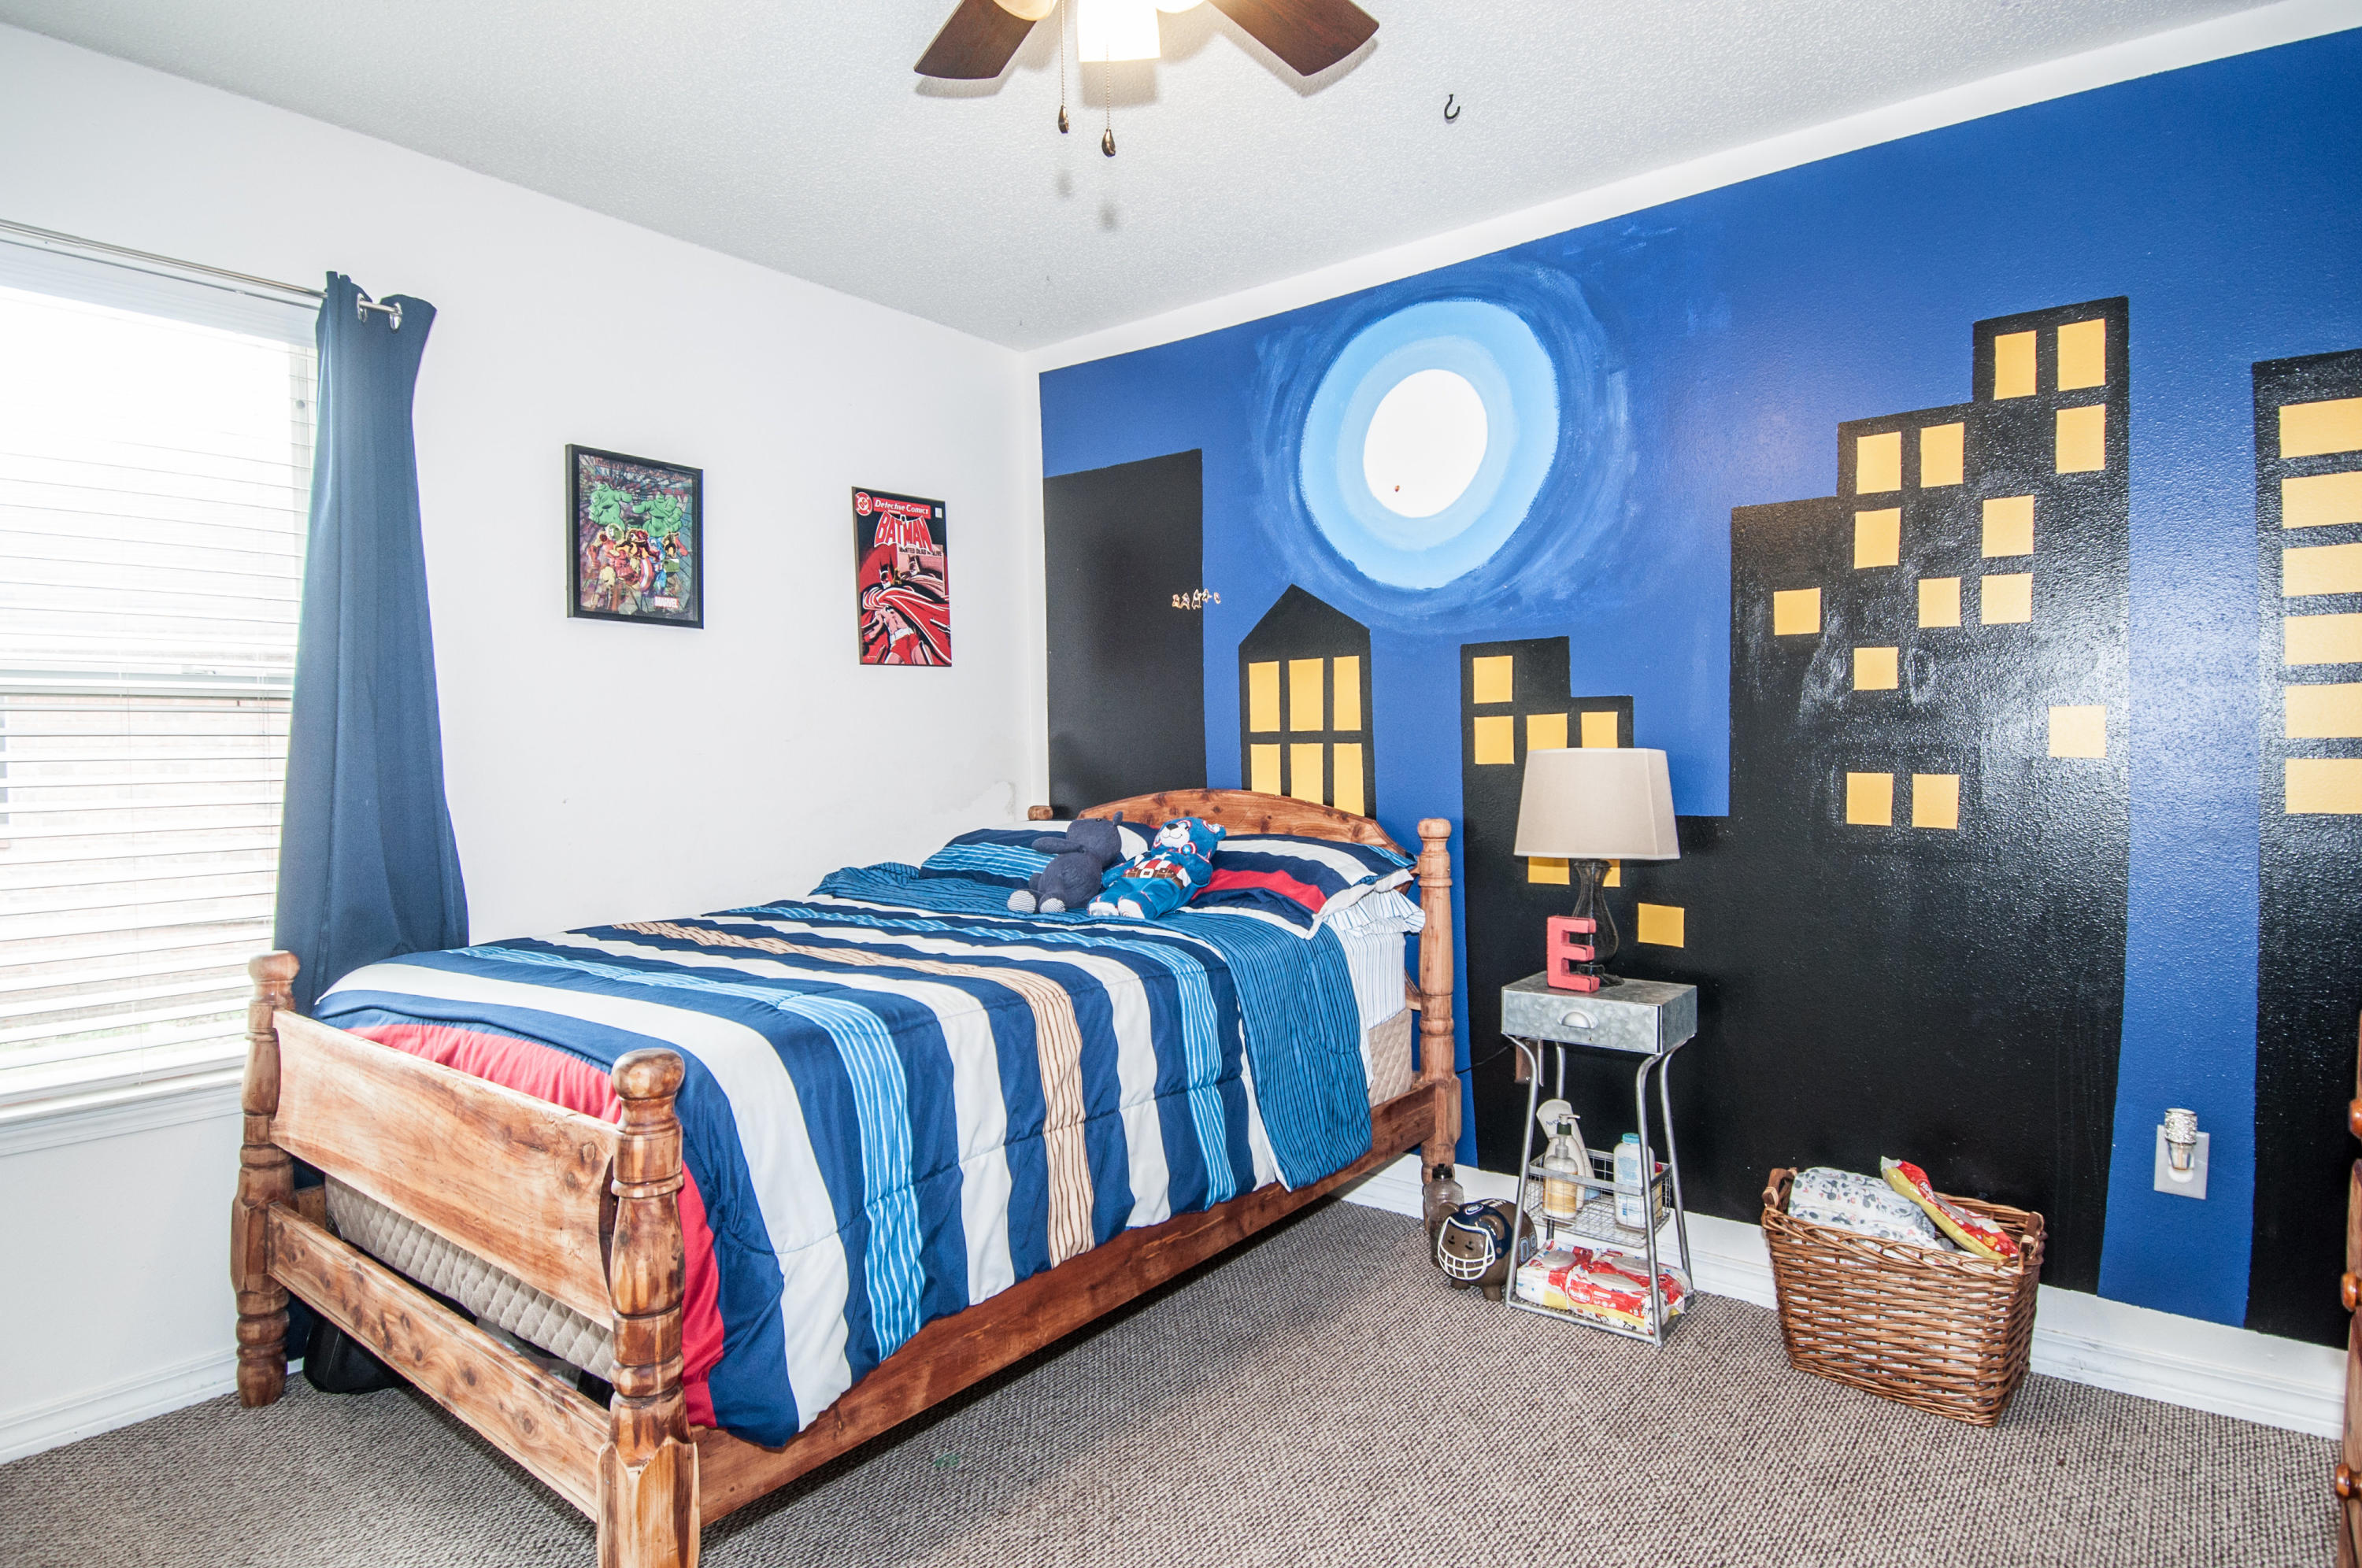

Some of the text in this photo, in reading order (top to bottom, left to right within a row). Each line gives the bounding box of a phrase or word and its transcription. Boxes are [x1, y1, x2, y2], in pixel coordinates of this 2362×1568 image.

[875, 499, 905, 511] Detective
[906, 504, 929, 515] Comics
[874, 510, 933, 553] BATMAN
[1547, 915, 1600, 993] E
